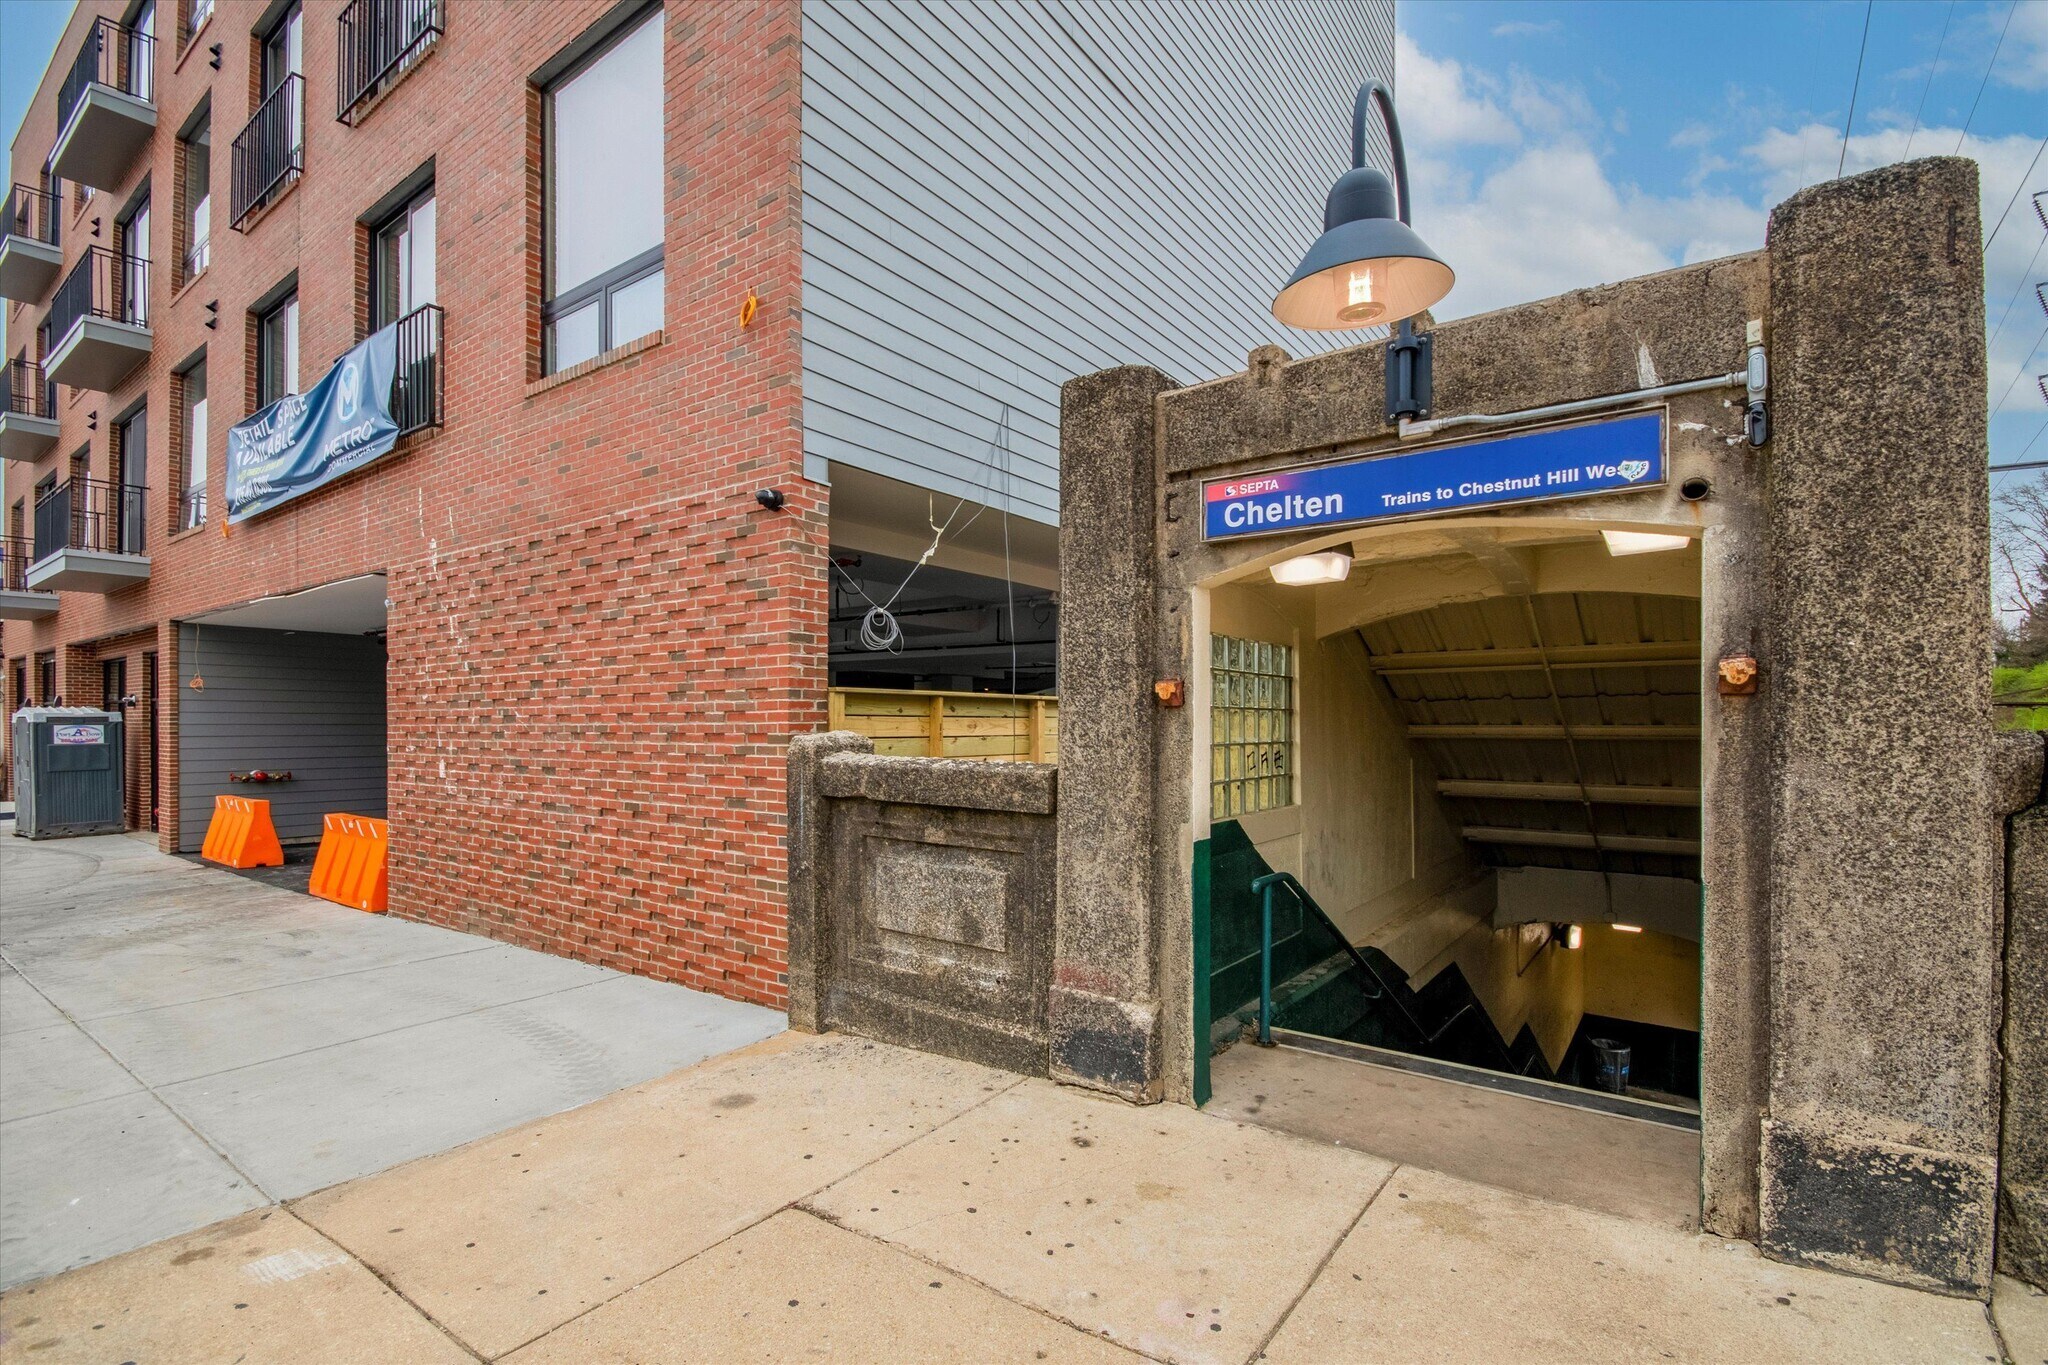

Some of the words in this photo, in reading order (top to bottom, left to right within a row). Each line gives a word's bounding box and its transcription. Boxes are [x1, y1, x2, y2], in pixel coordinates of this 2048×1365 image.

[277, 396, 308, 429] SPACE
[1239, 479, 1279, 494] SEPTA
[1381, 491, 1431, 507] Trains
[1436, 487, 1454, 500] to
[1459, 474, 1541, 497] Chestnut
[1546, 468, 1579, 485] Hill
[1585, 463, 1622, 480] We
[1224, 493, 1343, 528] Chelten
